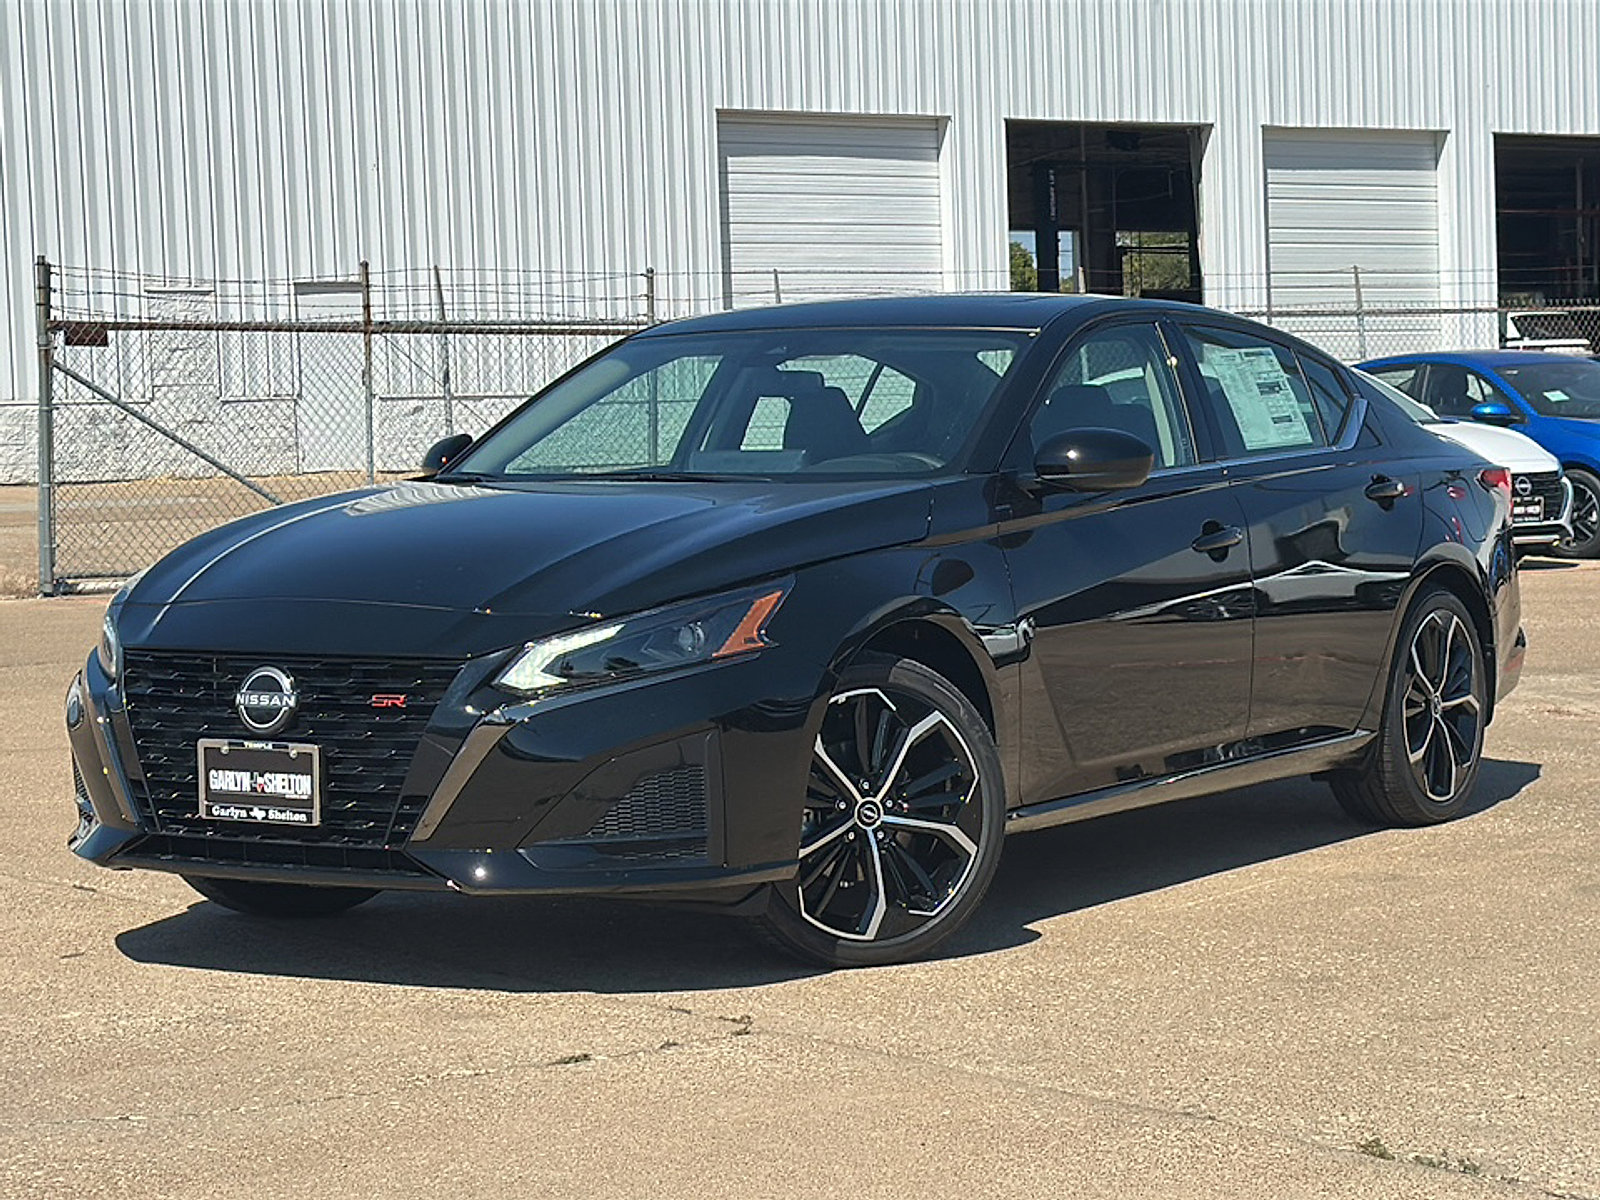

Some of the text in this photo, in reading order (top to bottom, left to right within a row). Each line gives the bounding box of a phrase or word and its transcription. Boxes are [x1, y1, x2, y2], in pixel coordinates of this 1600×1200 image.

[235, 694, 296, 707] NISSAN
[371, 693, 407, 708] SR
[209, 769, 312, 795] GARLYN SHELTON
[211, 805, 307, 822] Garlyn Shelton
